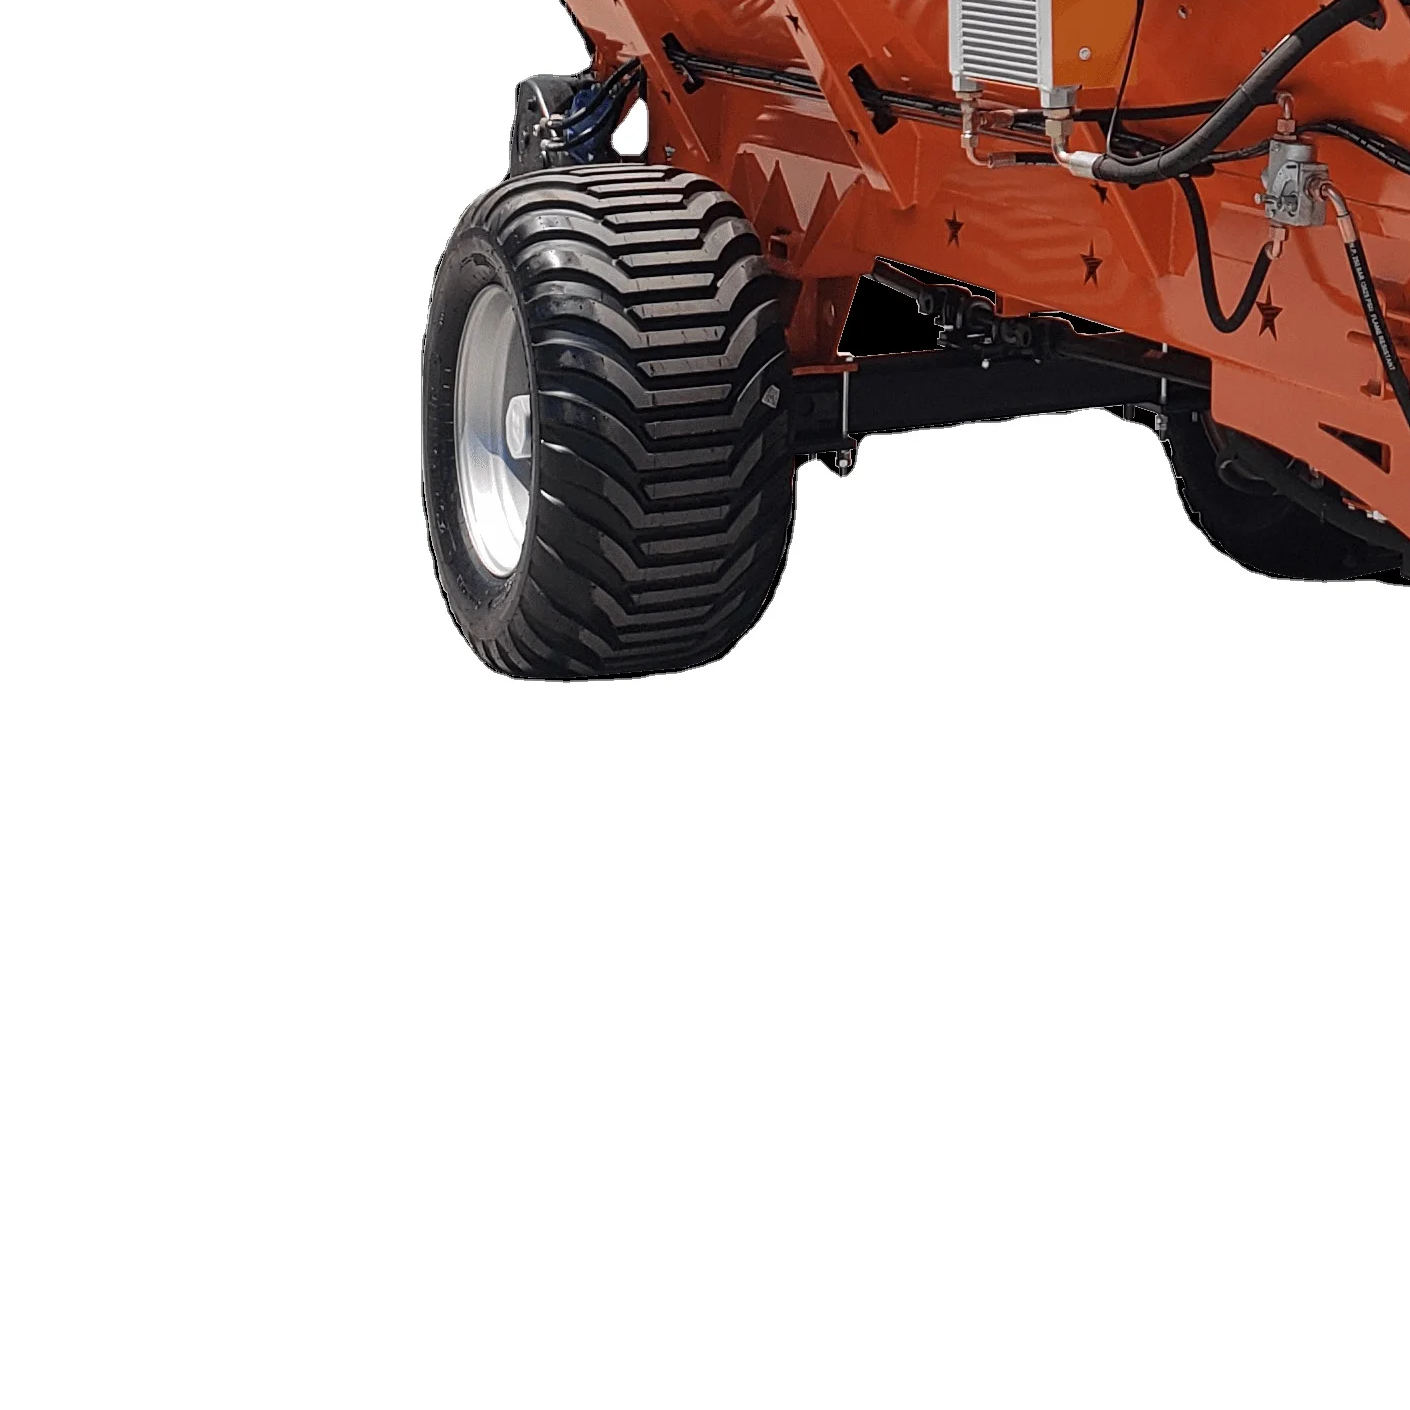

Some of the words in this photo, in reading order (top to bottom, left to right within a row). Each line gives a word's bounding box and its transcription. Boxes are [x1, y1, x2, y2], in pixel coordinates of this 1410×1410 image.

[1356, 267, 1365, 280] BAR
[1370, 313, 1382, 336] FLAME
[1378, 335, 1396, 370] RESISTANT
